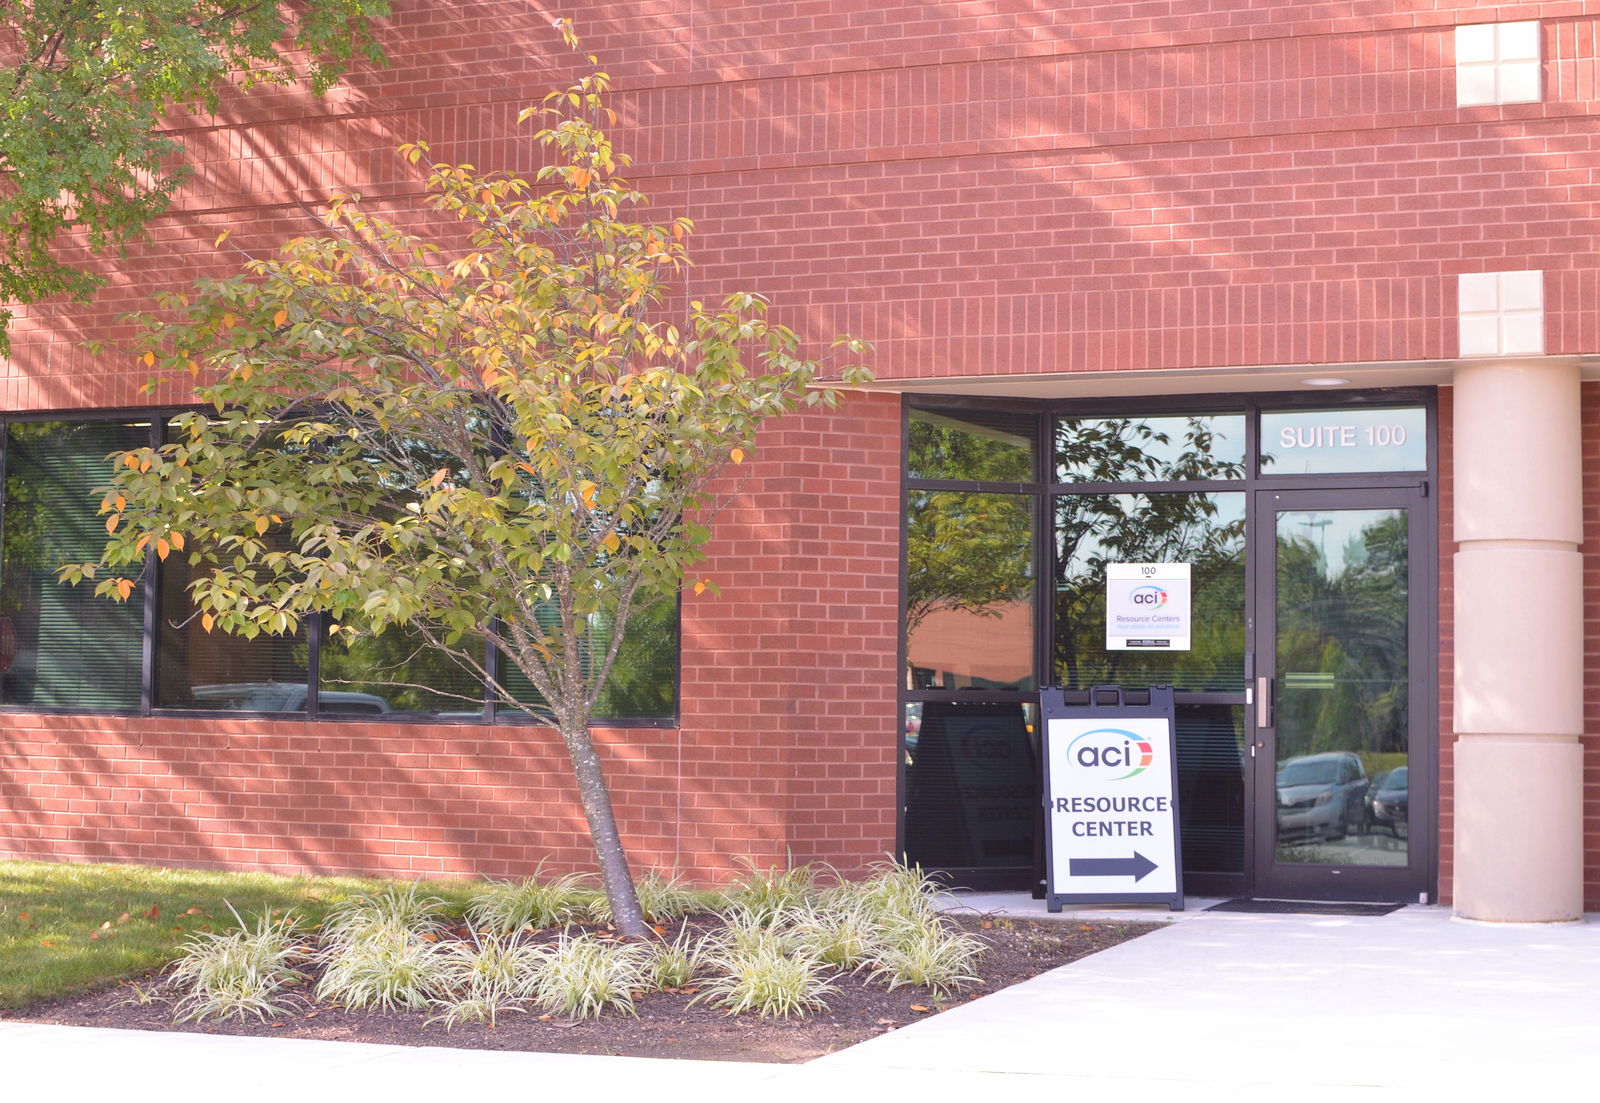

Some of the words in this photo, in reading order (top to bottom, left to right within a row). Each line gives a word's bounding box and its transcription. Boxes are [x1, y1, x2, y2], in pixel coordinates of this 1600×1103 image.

[1280, 426, 1356, 448] SUITE
[1365, 424, 1406, 446] 100
[1134, 591, 1157, 604] aci
[1077, 740, 1130, 767] aci
[1056, 797, 1167, 813] RESOURCE
[1072, 821, 1154, 837] CENTER
